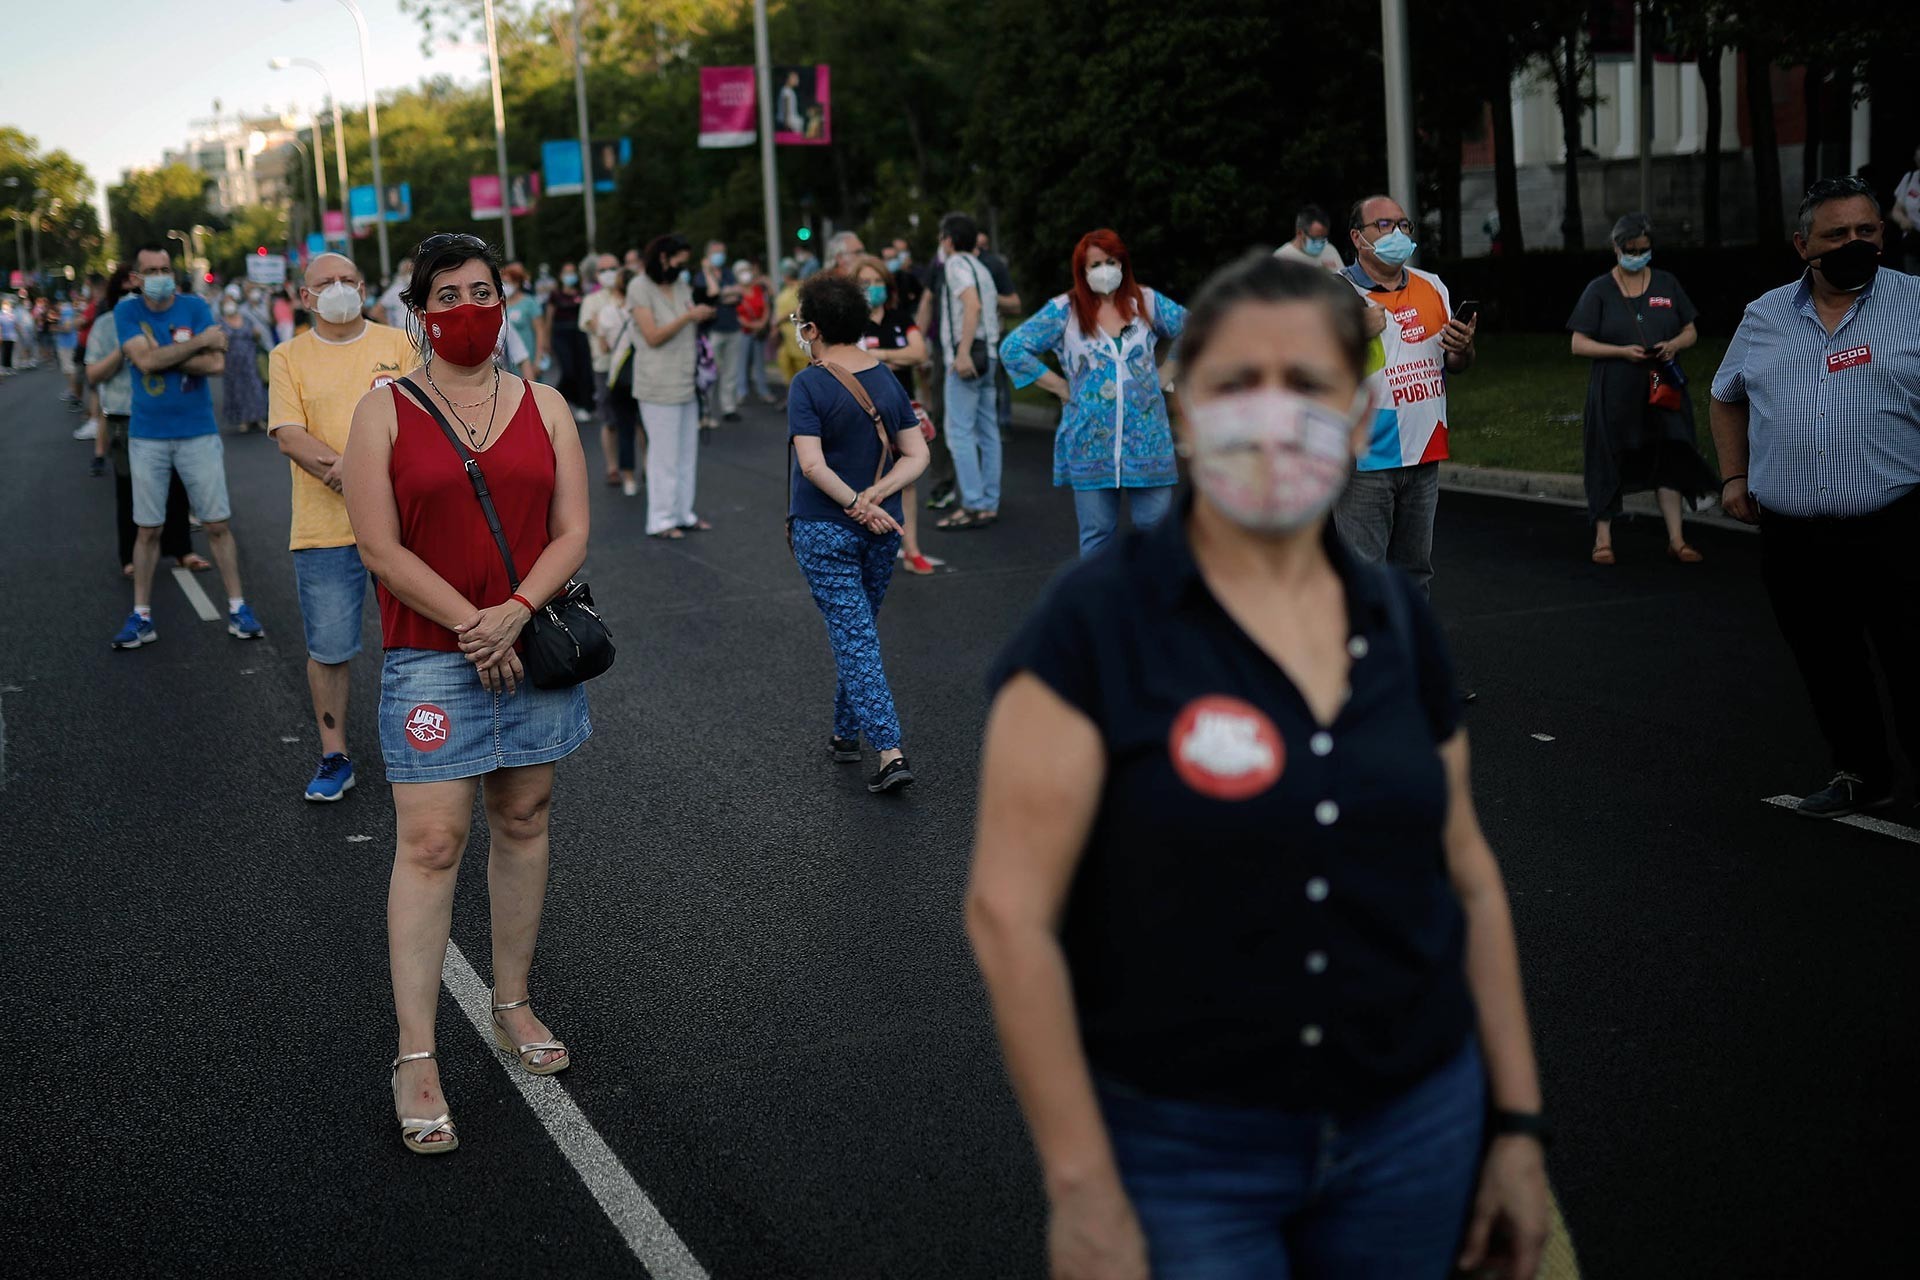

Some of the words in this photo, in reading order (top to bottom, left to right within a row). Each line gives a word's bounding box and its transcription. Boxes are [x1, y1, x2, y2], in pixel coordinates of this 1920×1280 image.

[1394, 308, 1418, 322] CCOO
[1401, 325, 1425, 339] CCOO
[1829, 347, 1868, 365] CCOO
[1384, 366, 1396, 377] EN
[1396, 359, 1428, 374] DEFENSA
[413, 709, 444, 729] UGT
